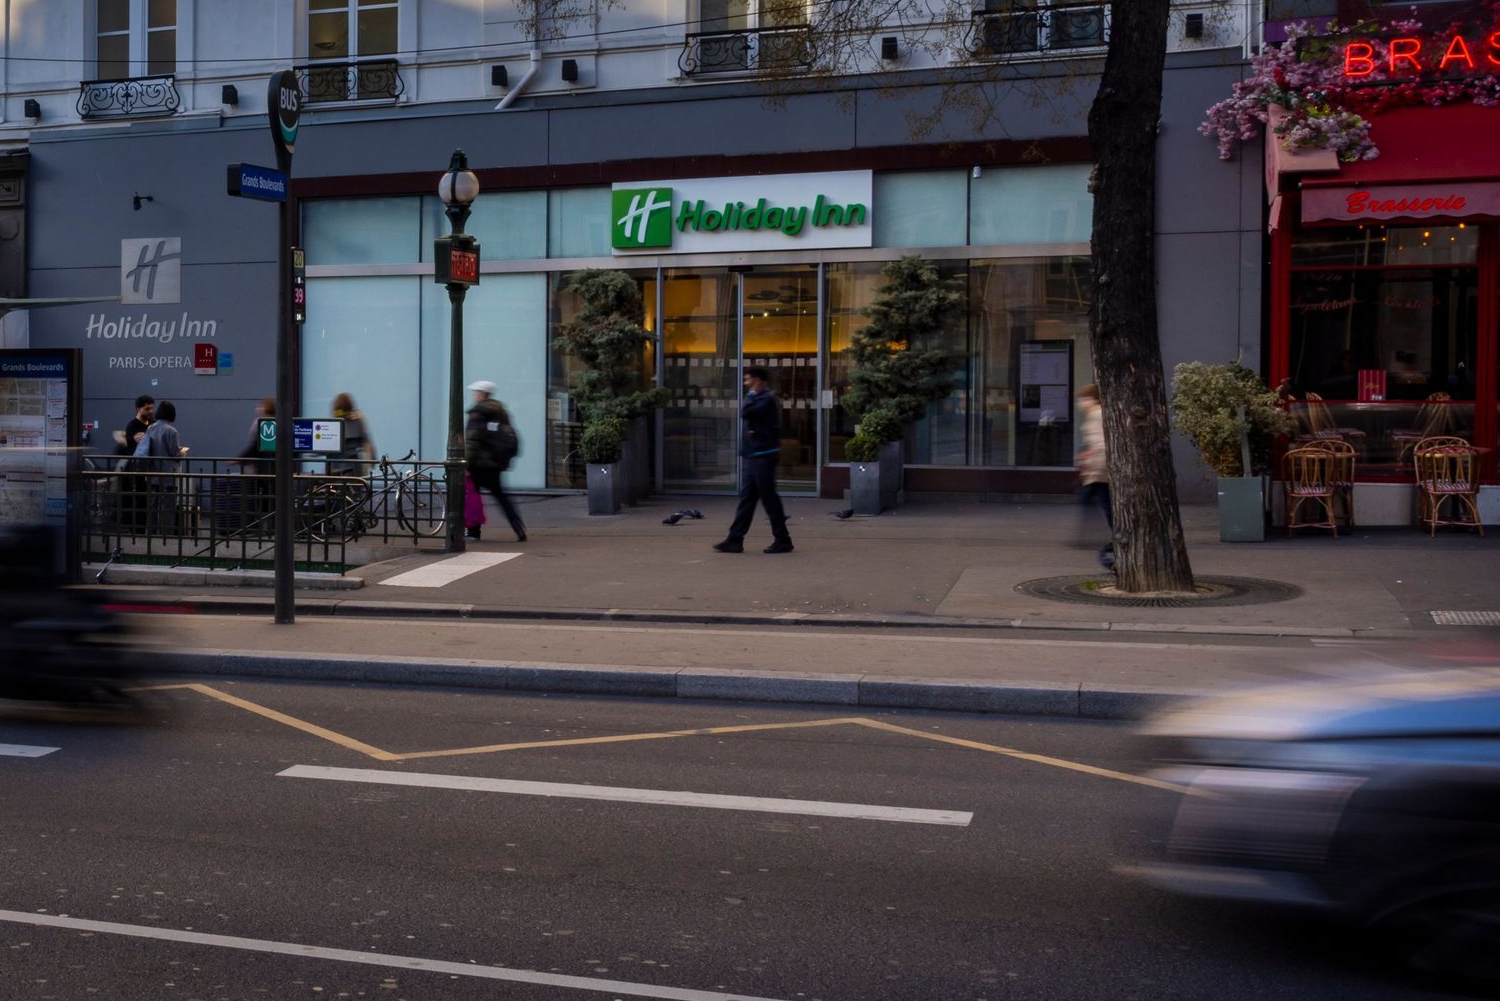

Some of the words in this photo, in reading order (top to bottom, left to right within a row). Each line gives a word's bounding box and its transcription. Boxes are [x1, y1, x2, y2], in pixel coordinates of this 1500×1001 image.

[280, 87, 298, 112] BUS
[242, 173, 259, 188] Grands
[259, 176, 285, 193] Boulevards
[1346, 191, 1467, 214] Brasserie
[676, 198, 807, 236] Holiday
[811, 194, 867, 227] Inn
[294, 288, 303, 303] 39
[85, 313, 177, 344] Holiday
[179, 311, 217, 338] Inn
[2, 363, 26, 371] Grands
[27, 363, 64, 371] Boulevards
[109, 356, 192, 369] PARIS-OPERA
[263, 424, 275, 437] M
